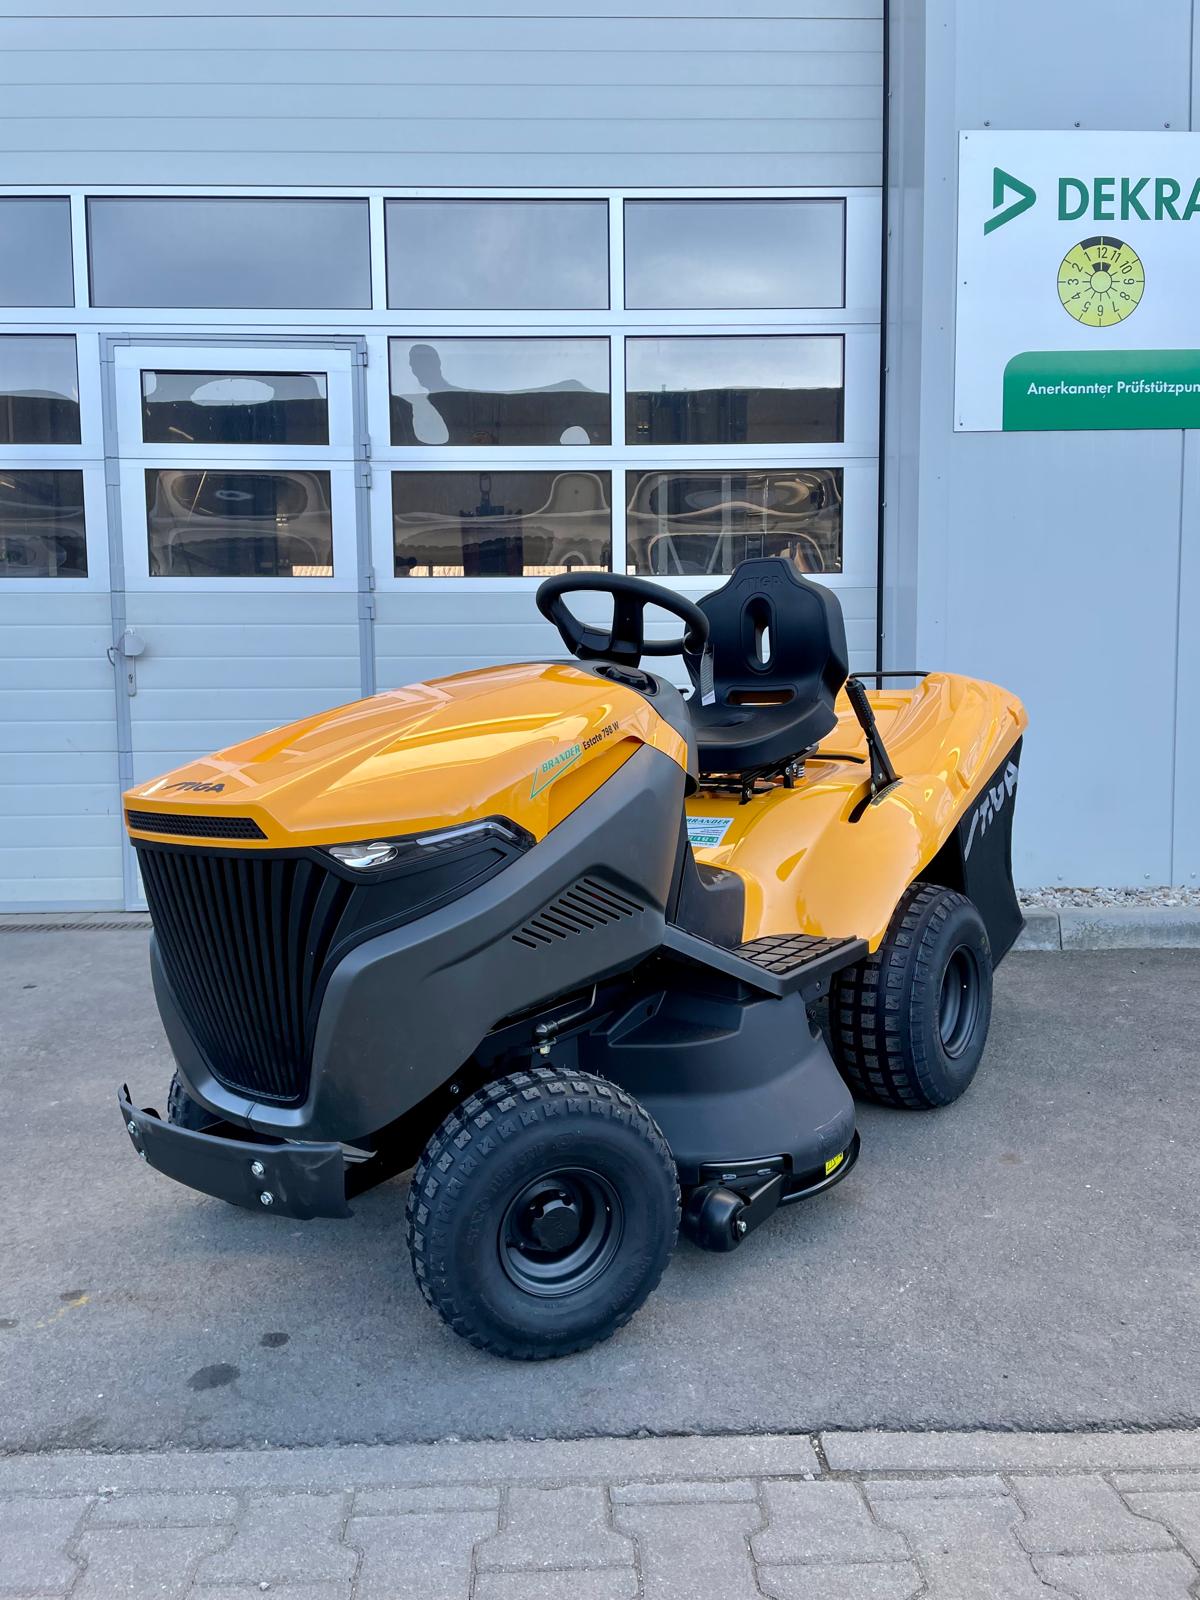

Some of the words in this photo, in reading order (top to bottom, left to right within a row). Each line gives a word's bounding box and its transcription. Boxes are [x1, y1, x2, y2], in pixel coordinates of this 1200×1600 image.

[1096, 246, 1108, 259] 12
[1110, 250, 1122, 263] 11
[1119, 260, 1133, 275] 10
[1026, 380, 1113, 395] Anerkannter
[542, 744, 581, 773] BRANDER
[582, 733, 603, 750] Estate
